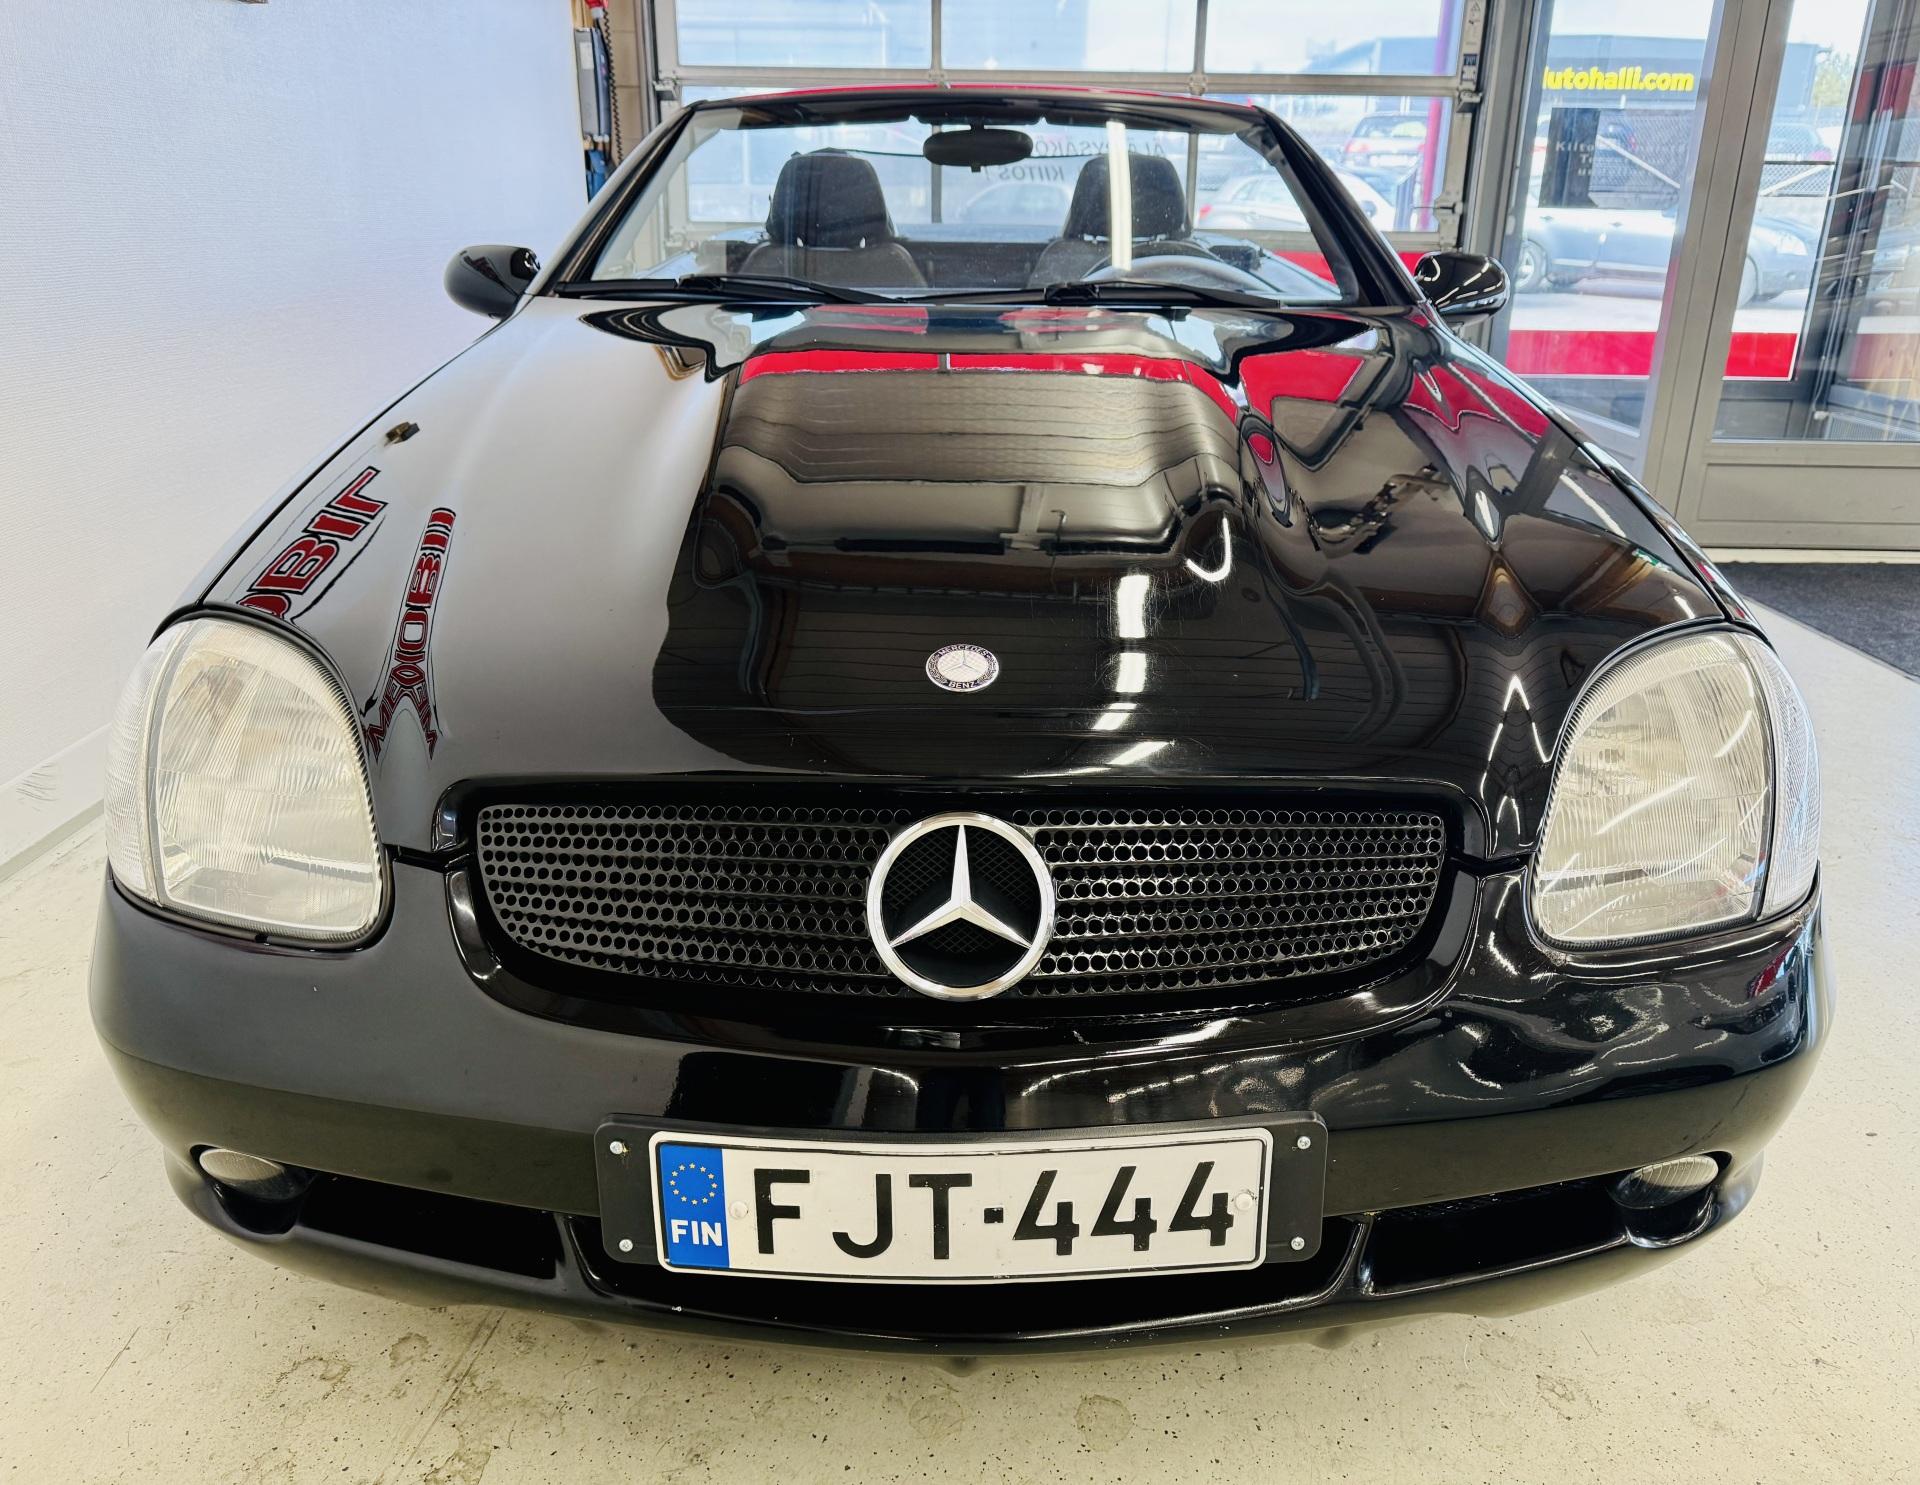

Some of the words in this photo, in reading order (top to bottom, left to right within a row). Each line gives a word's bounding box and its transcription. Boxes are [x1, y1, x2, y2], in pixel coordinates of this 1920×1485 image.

[938, 644, 990, 656] MERCEDES
[948, 680, 977, 689] BENZ
[753, 1160, 1234, 1260] FJT-444
[672, 1219, 724, 1248] FIN
